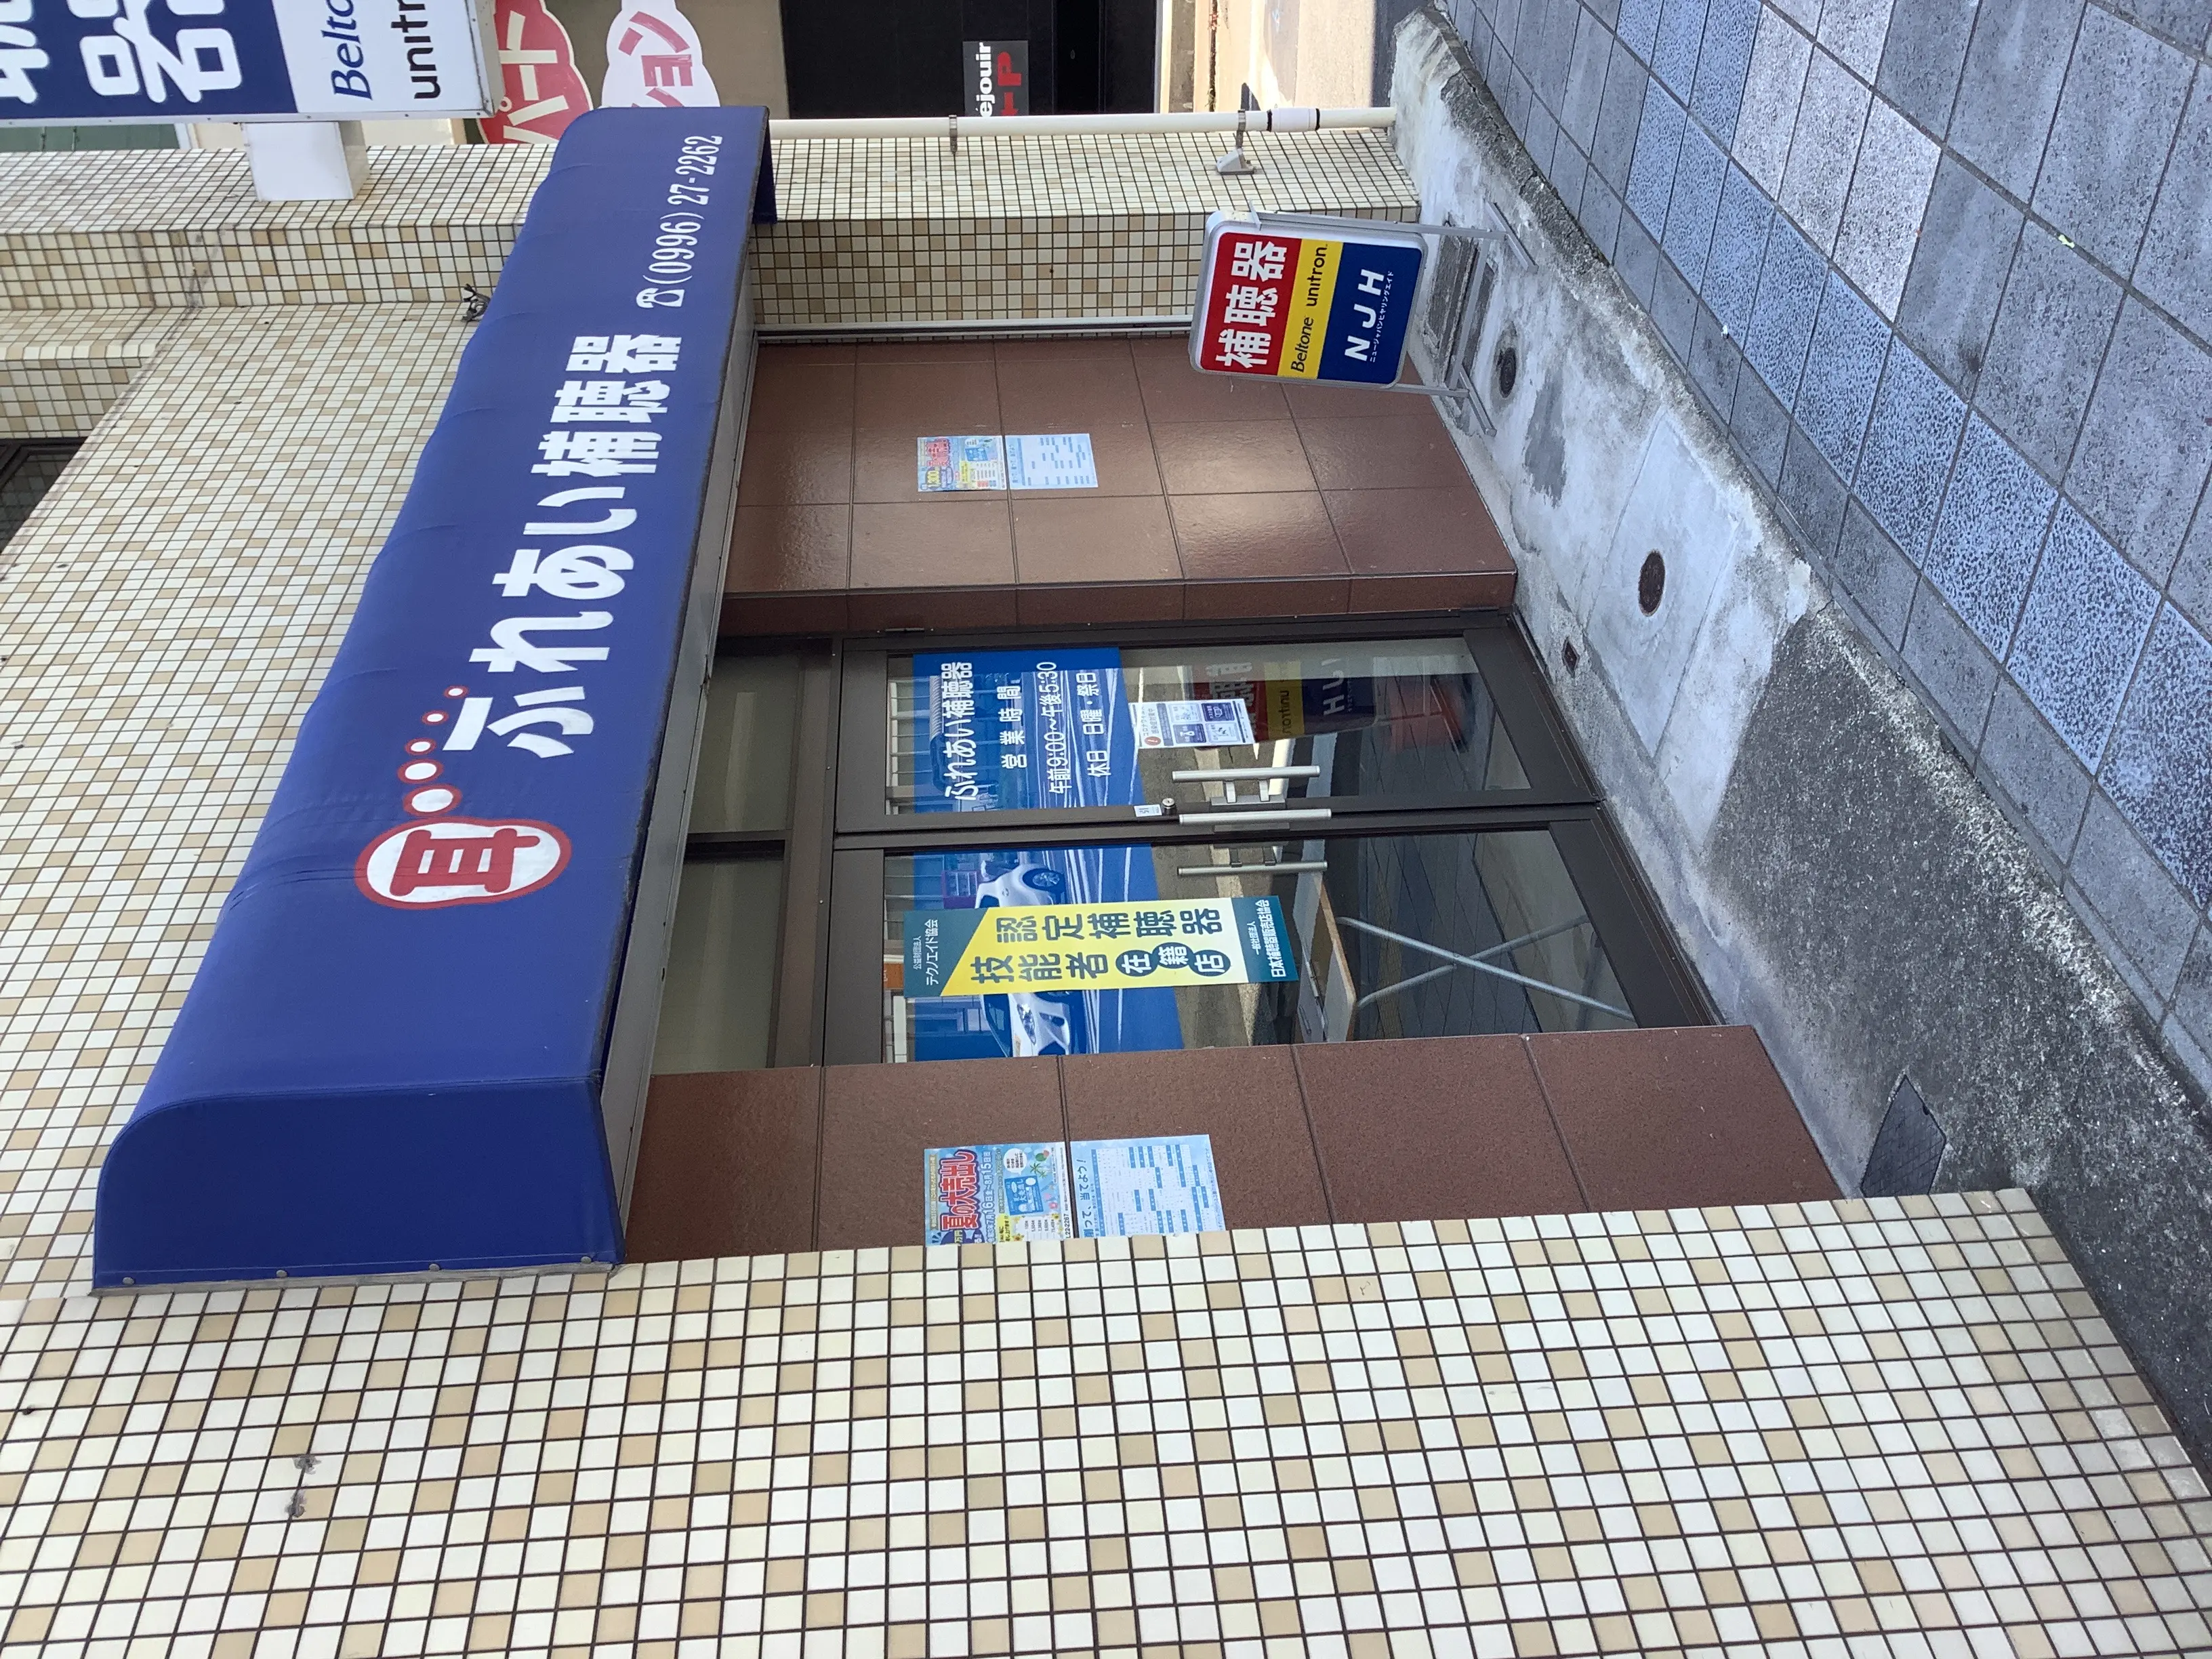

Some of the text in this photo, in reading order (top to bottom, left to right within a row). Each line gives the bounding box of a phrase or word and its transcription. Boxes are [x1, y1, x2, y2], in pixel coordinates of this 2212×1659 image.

[0, 0, 242, 102] 器
[997, 52, 1021, 87] P
[667, 135, 723, 205] 27-2262
[1215, 241, 1287, 368] 補聴器
[1290, 247, 1328, 373] Beltone unitron
[1370, 270, 1393, 363] ニュージャパンヒヤリングエイド
[442, 333, 682, 758] ふれあい補聴器
[941, 662, 979, 800] ふれあい補聴器
[912, 935, 922, 970] 公益財団法人
[924, 918, 939, 986] テクノエイド協会
[996, 908, 1223, 943] 認定補聴器
[1247, 920, 1261, 955] 一般社団法人
[1255, 899, 1286, 977] 日本補聴器販売店協会
[939, 1151, 979, 1231] 夏の大売出し
